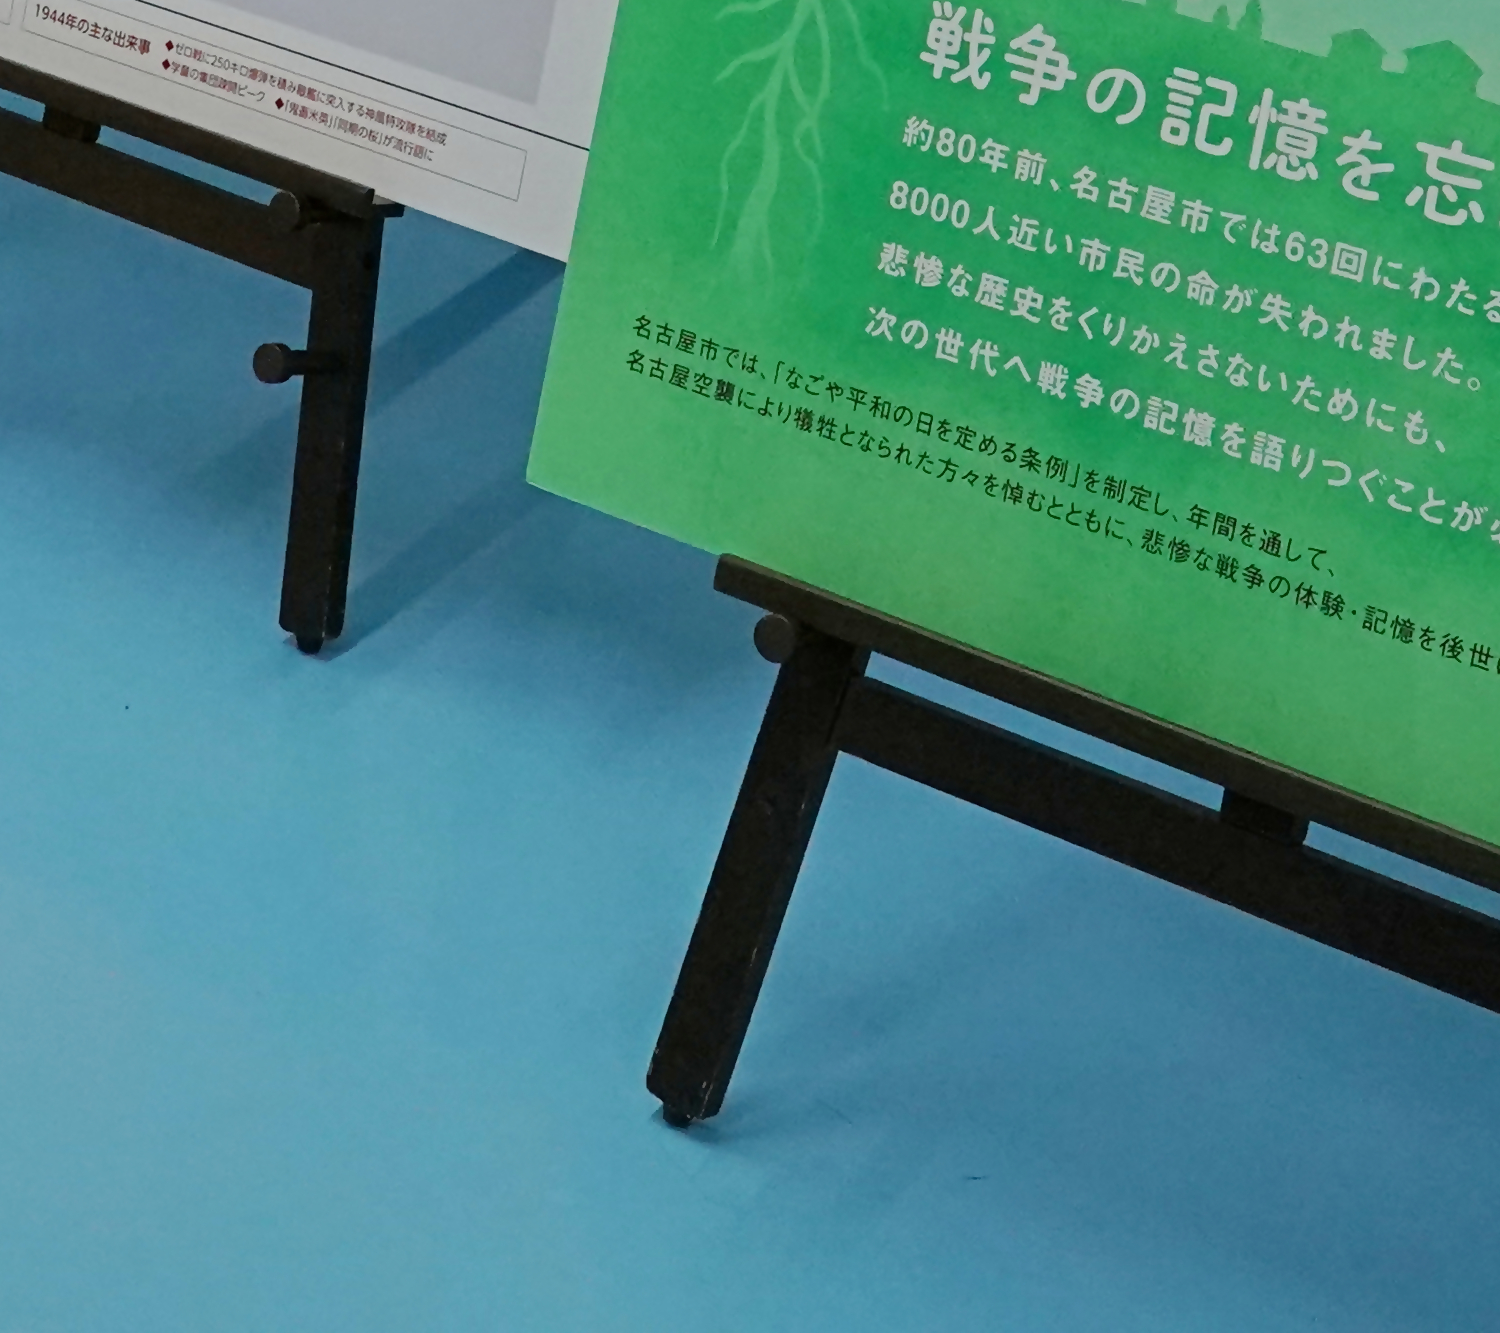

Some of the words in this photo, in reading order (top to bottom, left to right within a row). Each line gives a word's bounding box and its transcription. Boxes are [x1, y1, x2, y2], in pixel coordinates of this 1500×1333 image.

[34, 2, 152, 57] 1944年の主な出来事
[877, 241, 1449, 454] 悲惨な歴史をくりかえさないためにも、
[889, 179, 1483, 394] 8000人近い市民の命が失われました。
[631, 315, 1336, 579] 名古屋市では、「なごや平和の日を定める条例」を制定し、年間を通して、
